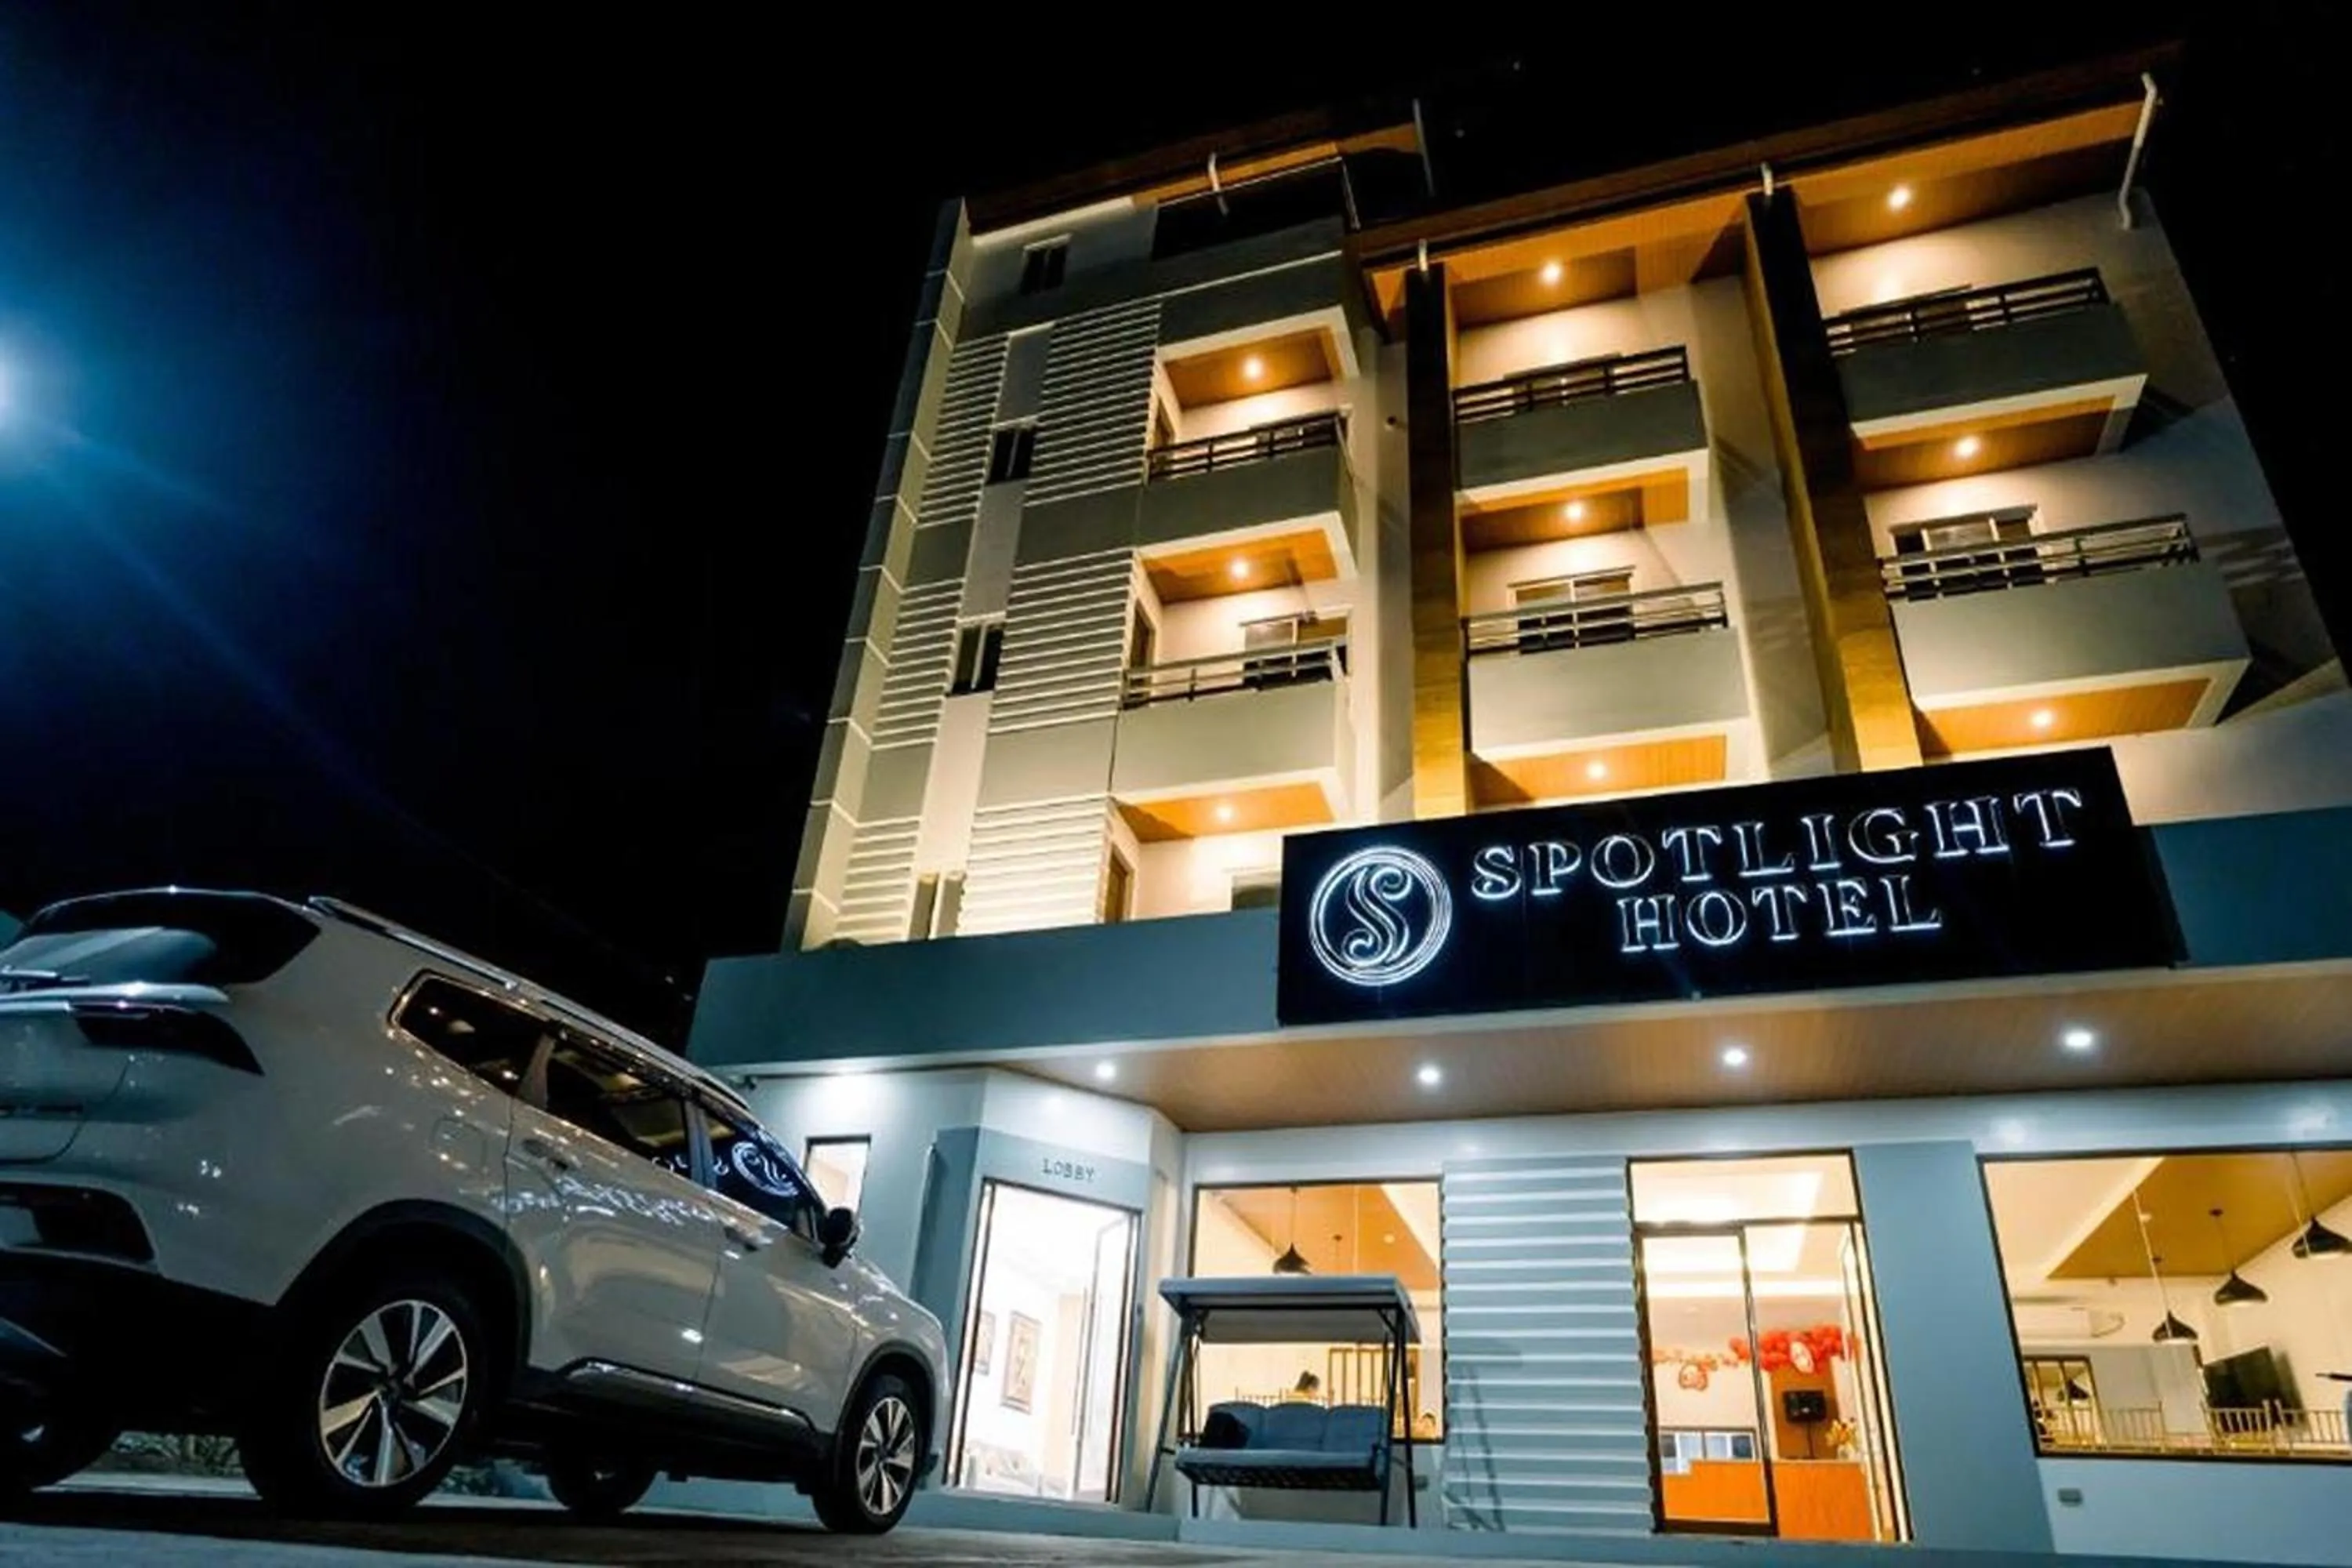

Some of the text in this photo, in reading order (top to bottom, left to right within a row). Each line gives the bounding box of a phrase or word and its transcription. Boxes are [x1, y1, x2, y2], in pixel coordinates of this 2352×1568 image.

[1471, 787, 2082, 900] SPOTLIGHT
[1617, 874, 1943, 953] HOTEL
[1041, 1157, 1095, 1182] LOBBY
